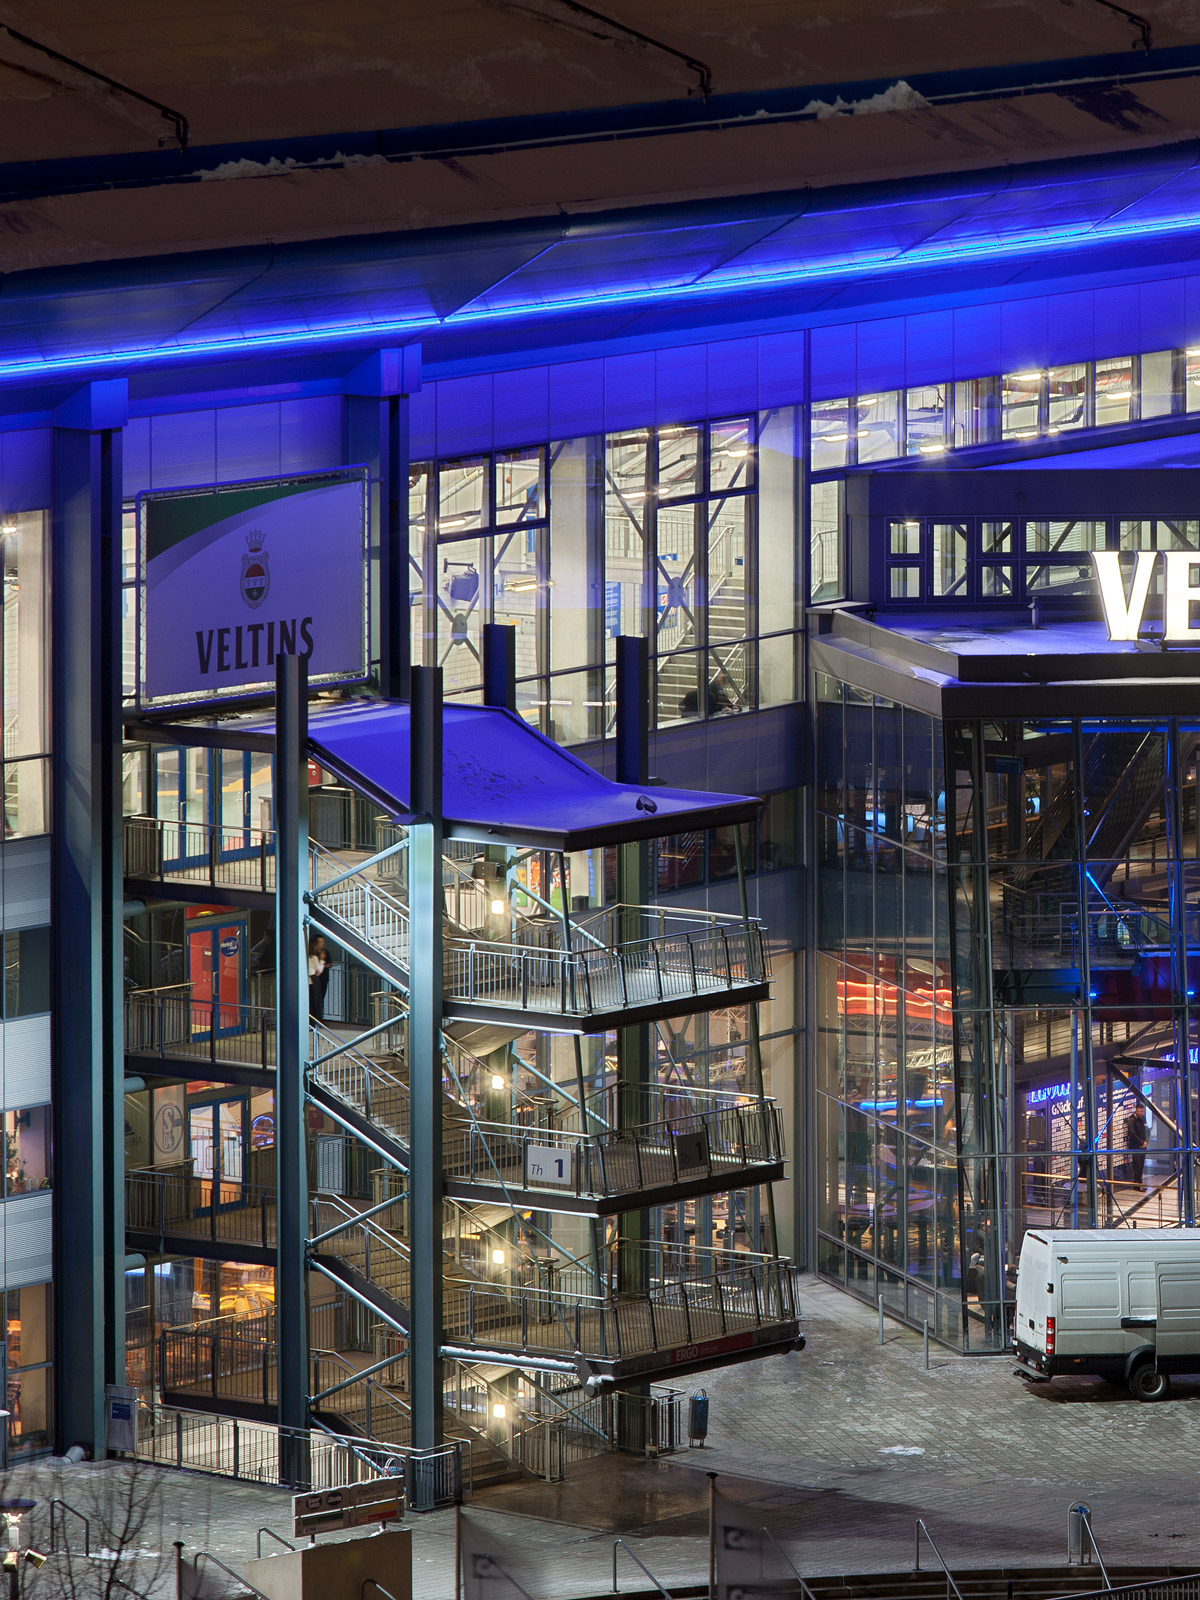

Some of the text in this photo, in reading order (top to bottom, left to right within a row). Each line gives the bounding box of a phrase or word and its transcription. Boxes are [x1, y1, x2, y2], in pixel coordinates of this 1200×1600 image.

[195, 616, 314, 675] VELTINS
[695, 1141, 703, 1161] 1
[530, 1158, 564, 1179] Th 1
[675, 1345, 699, 1362] ERGO
